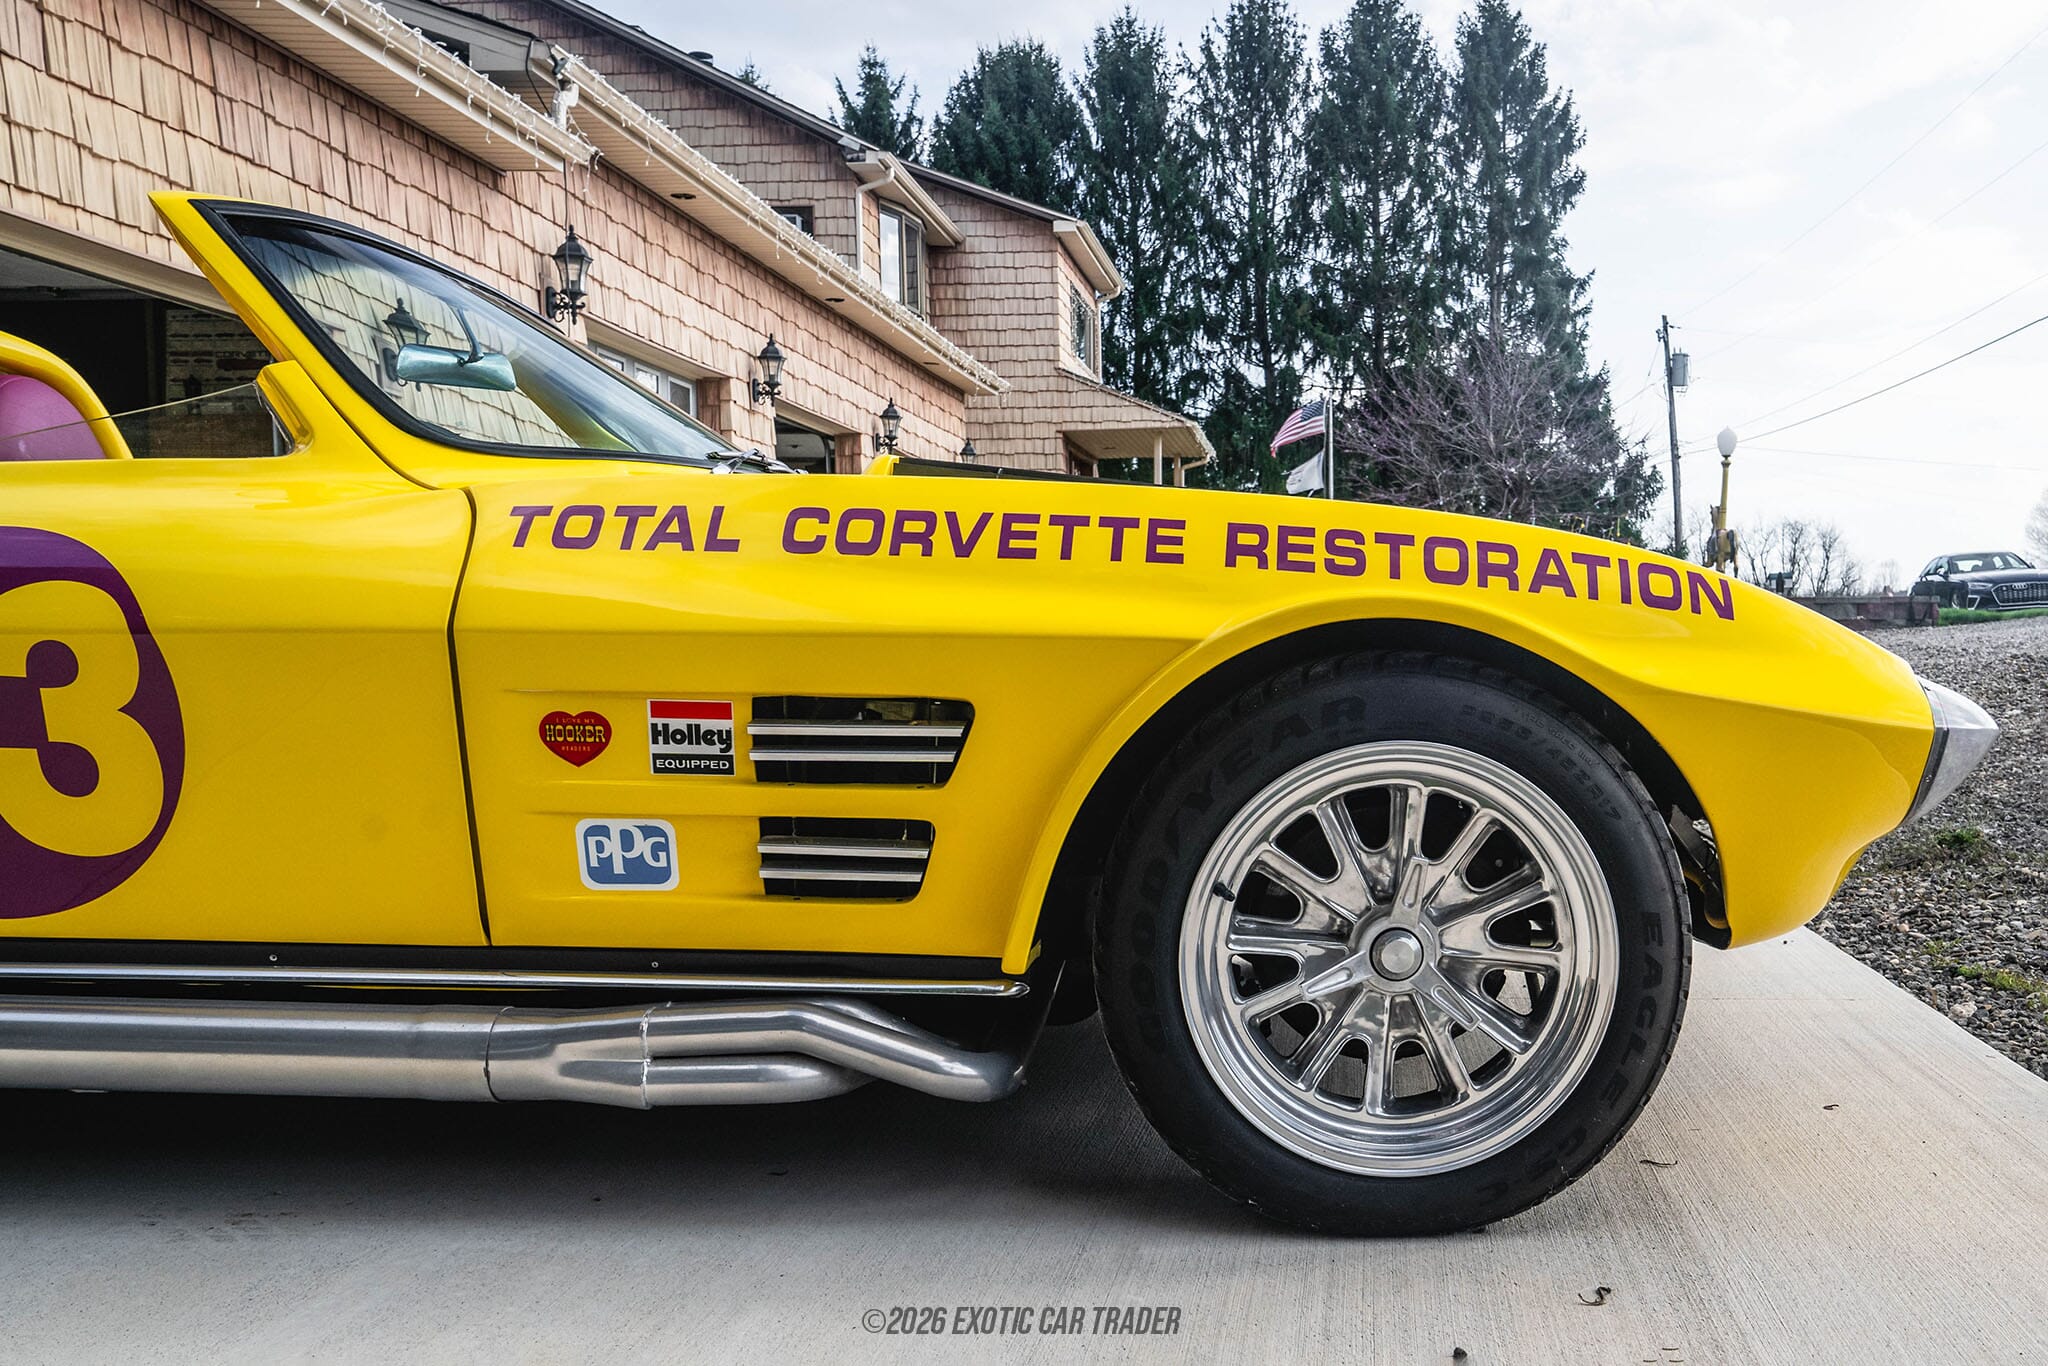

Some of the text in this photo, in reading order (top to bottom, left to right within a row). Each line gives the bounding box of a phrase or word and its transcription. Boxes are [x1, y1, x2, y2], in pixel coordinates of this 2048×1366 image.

[508, 505, 1735, 621] TOTAL CORVETTE RESTORATION
[0, 580, 164, 857] 3
[545, 724, 606, 743] HOOKER
[651, 723, 732, 753] Holley
[656, 759, 729, 769] EQUIPPED
[587, 824, 668, 875] PPG
[1597, 910, 1664, 1108] EAGLE
